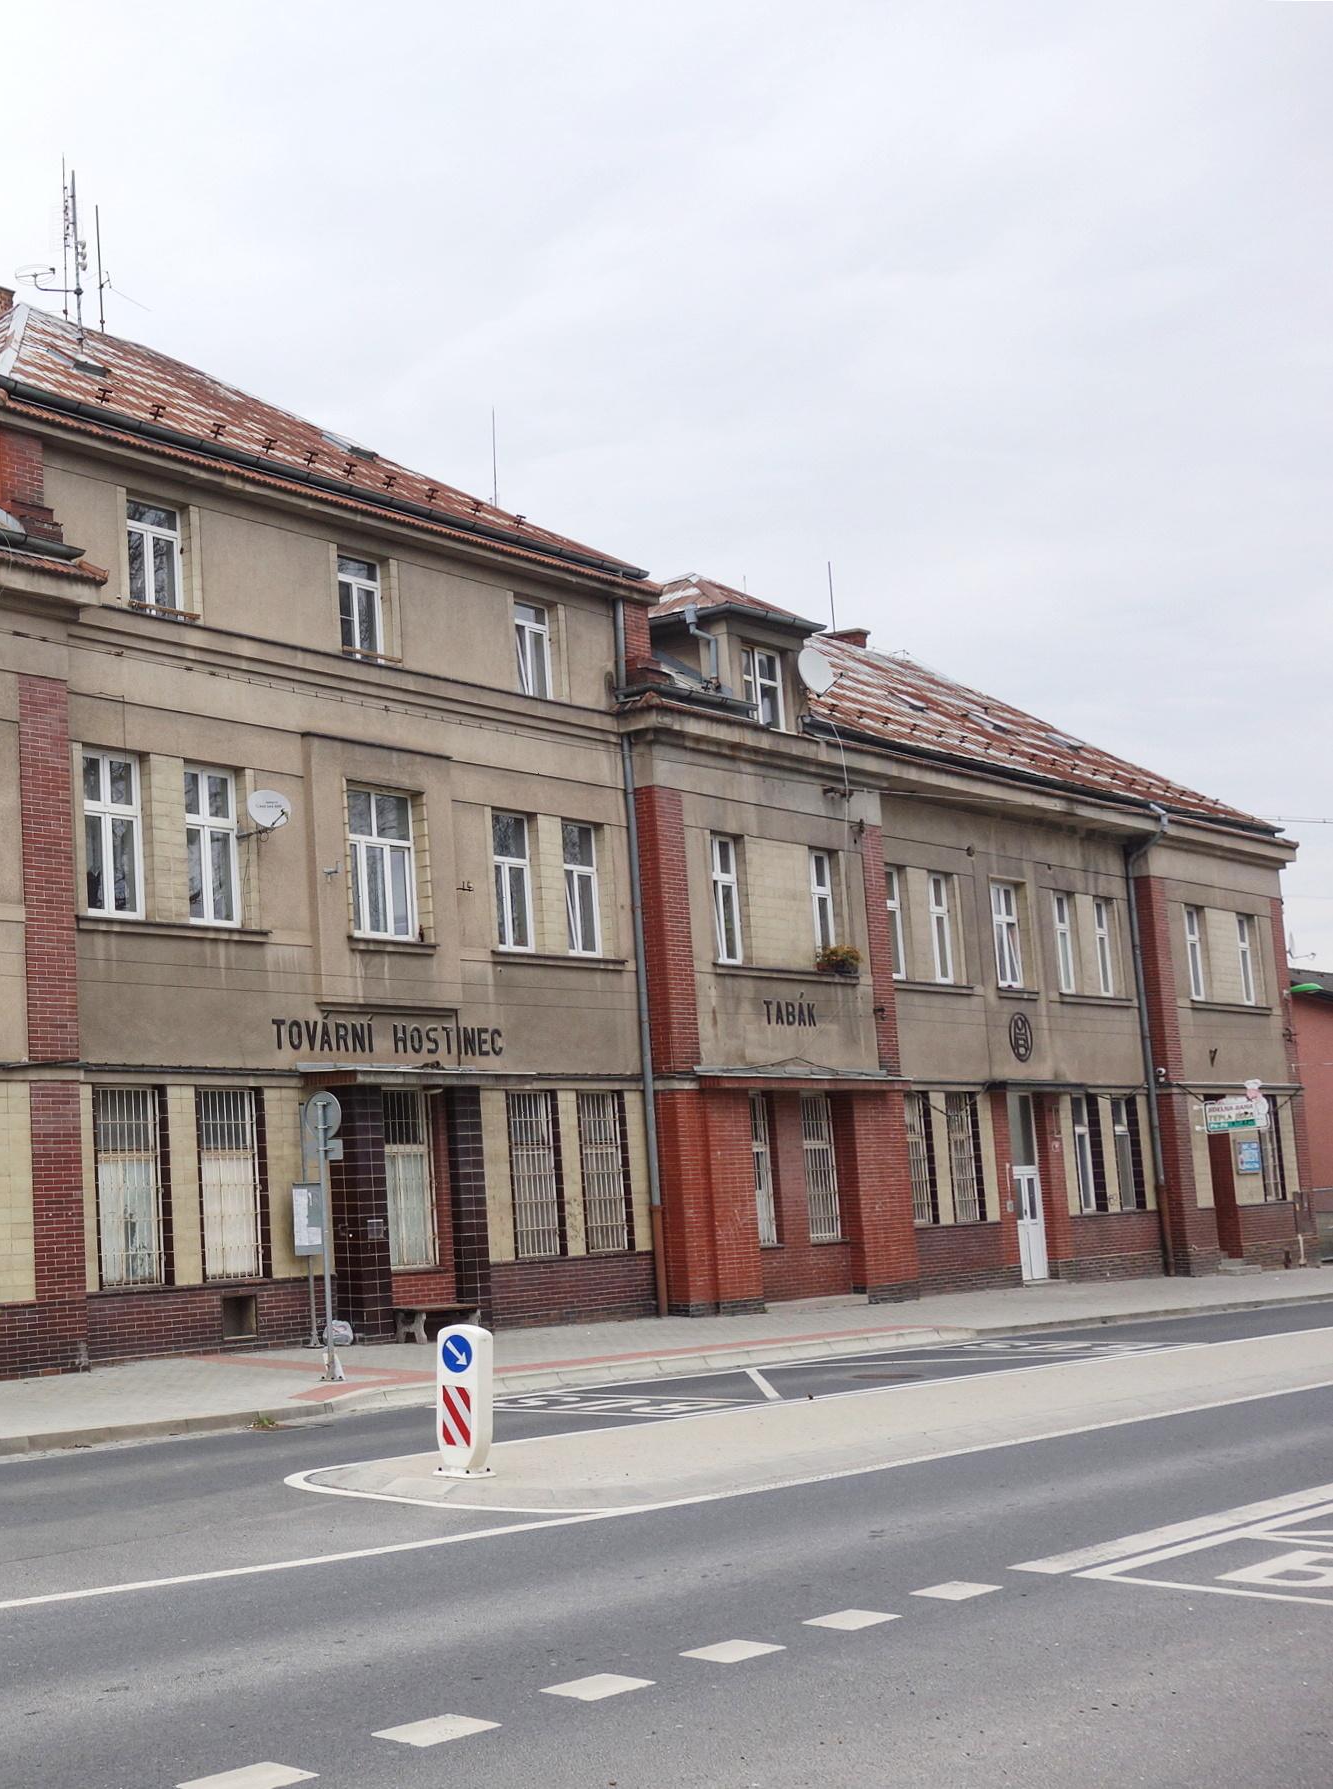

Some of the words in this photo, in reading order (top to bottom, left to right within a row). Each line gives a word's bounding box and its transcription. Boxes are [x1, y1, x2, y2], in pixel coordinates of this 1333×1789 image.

[763, 991, 816, 1027] TABÁK
[272, 1011, 373, 1053] TOVÁRNÍ
[392, 1023, 503, 1056] HOSTINEC
